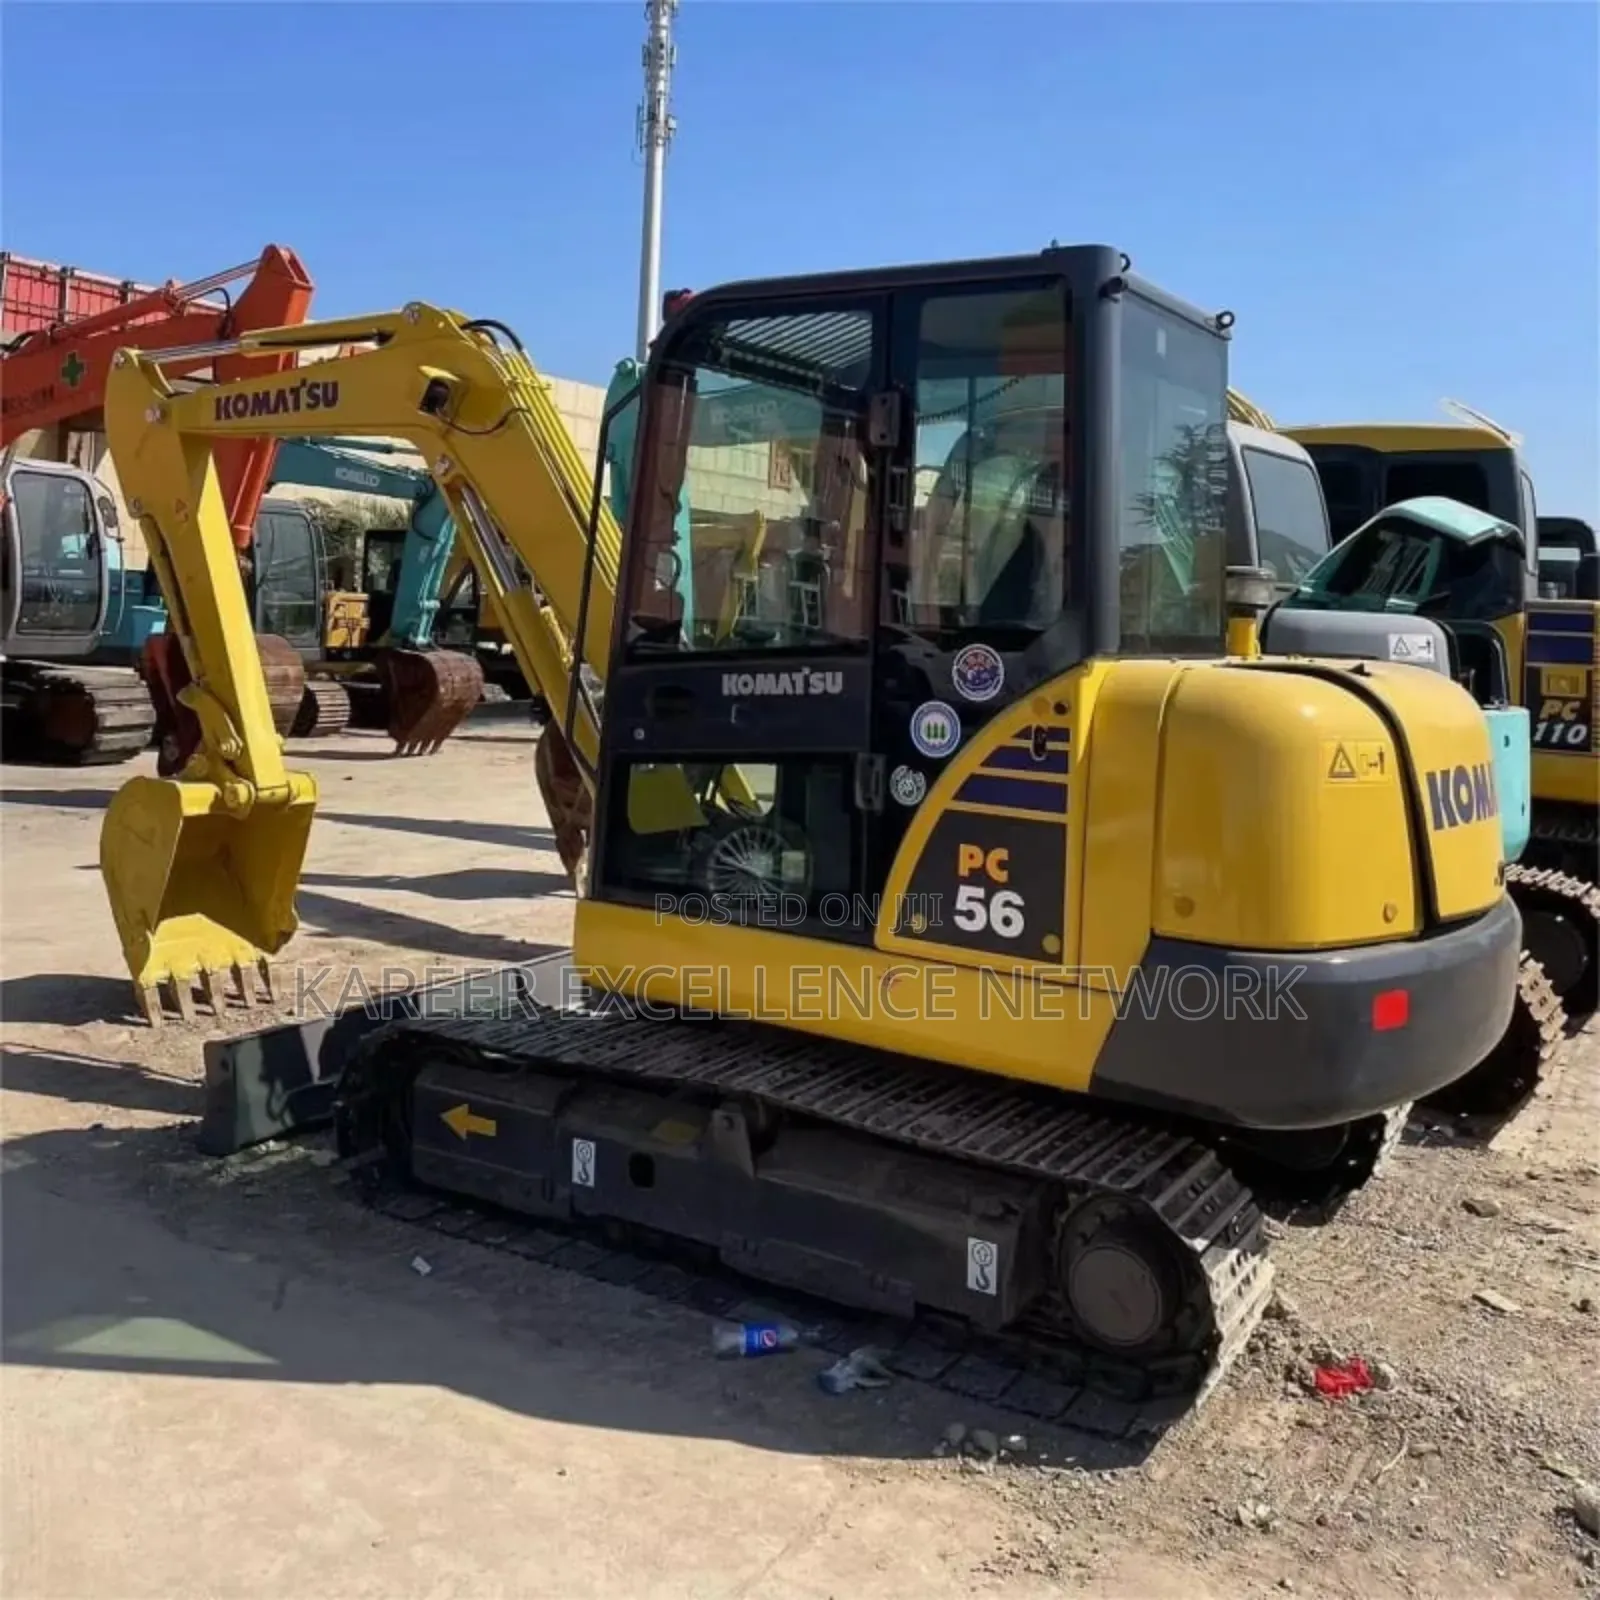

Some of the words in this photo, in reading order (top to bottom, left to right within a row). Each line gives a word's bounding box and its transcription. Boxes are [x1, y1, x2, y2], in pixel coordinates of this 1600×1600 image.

[214, 377, 339, 421] KOMATSU
[721, 666, 844, 696] KOMATSU
[1539, 699, 1581, 721] PC
[1533, 721, 1588, 745] 110
[958, 843, 1009, 883] PC
[953, 884, 1026, 939] 56
